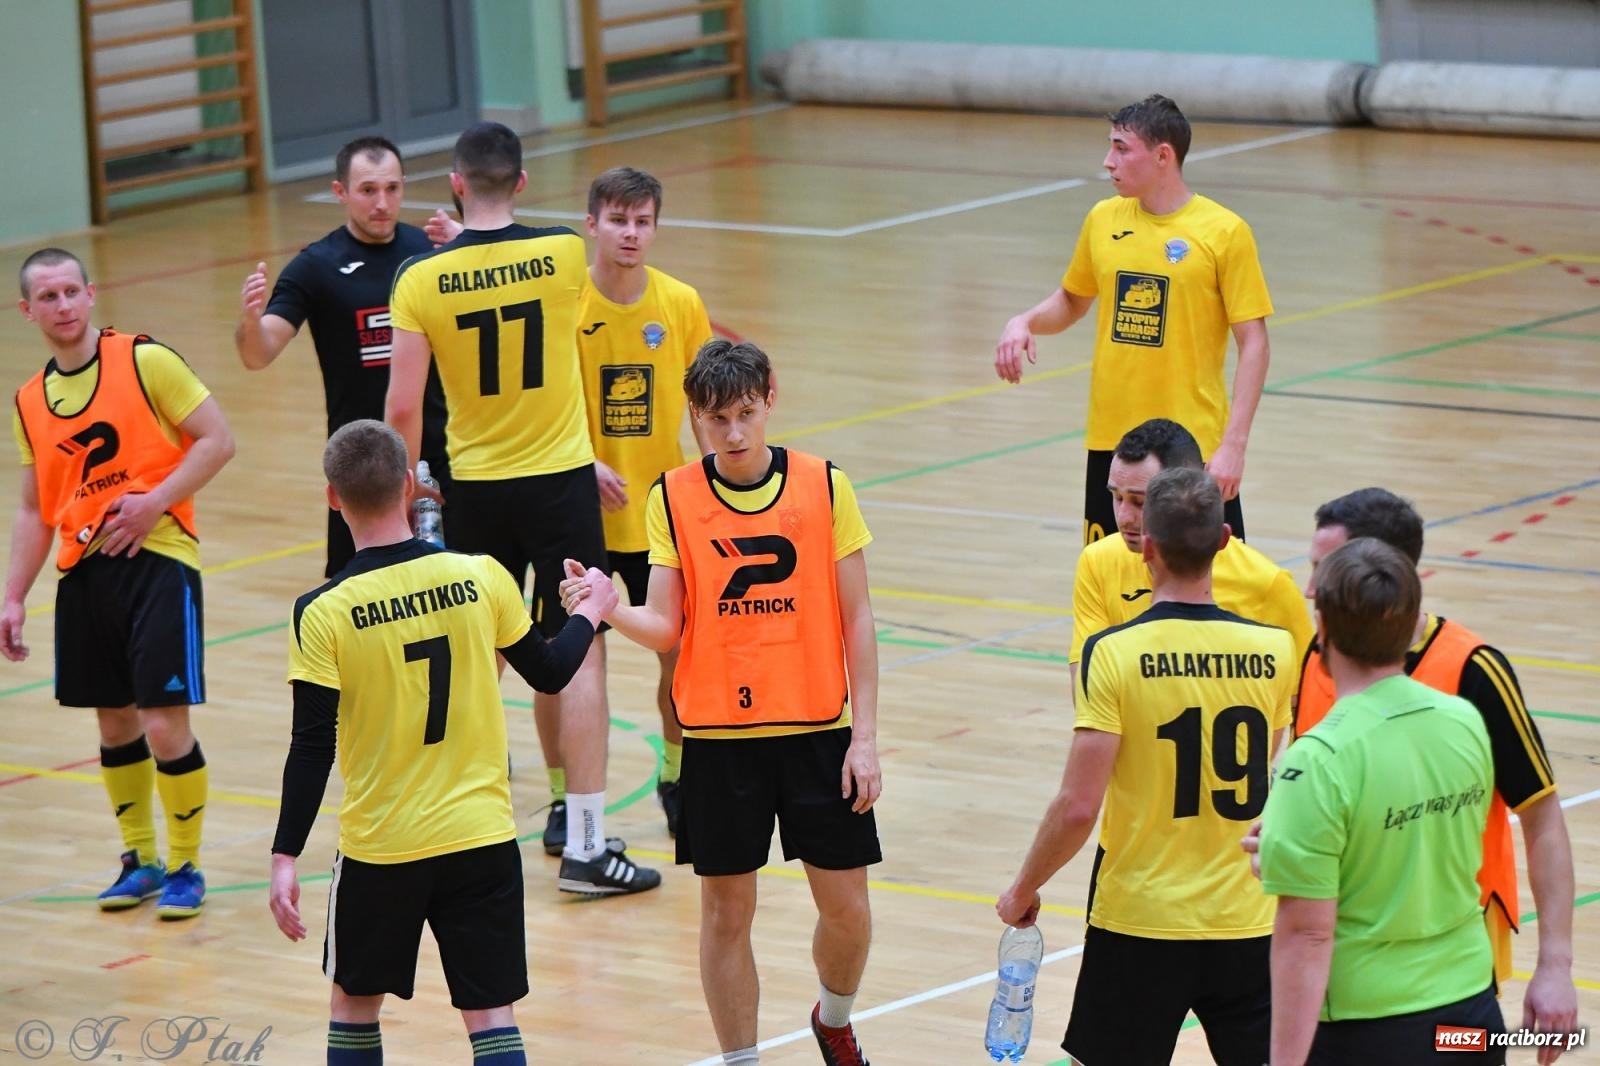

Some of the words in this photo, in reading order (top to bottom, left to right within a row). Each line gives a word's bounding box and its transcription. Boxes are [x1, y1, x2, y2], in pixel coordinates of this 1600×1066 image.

[438, 256, 556, 295] GALAKTIKOS
[1115, 322, 1160, 337] GARAGE
[455, 299, 545, 397] 77
[75, 469, 130, 501] PATRICK
[350, 579, 479, 631] GALAKTIKOS
[718, 597, 796, 617] PATRICK
[1139, 652, 1276, 680] GALAKTIKOS
[403, 634, 452, 746] 7
[738, 686, 753, 709] 3
[1156, 705, 1269, 822] 19
